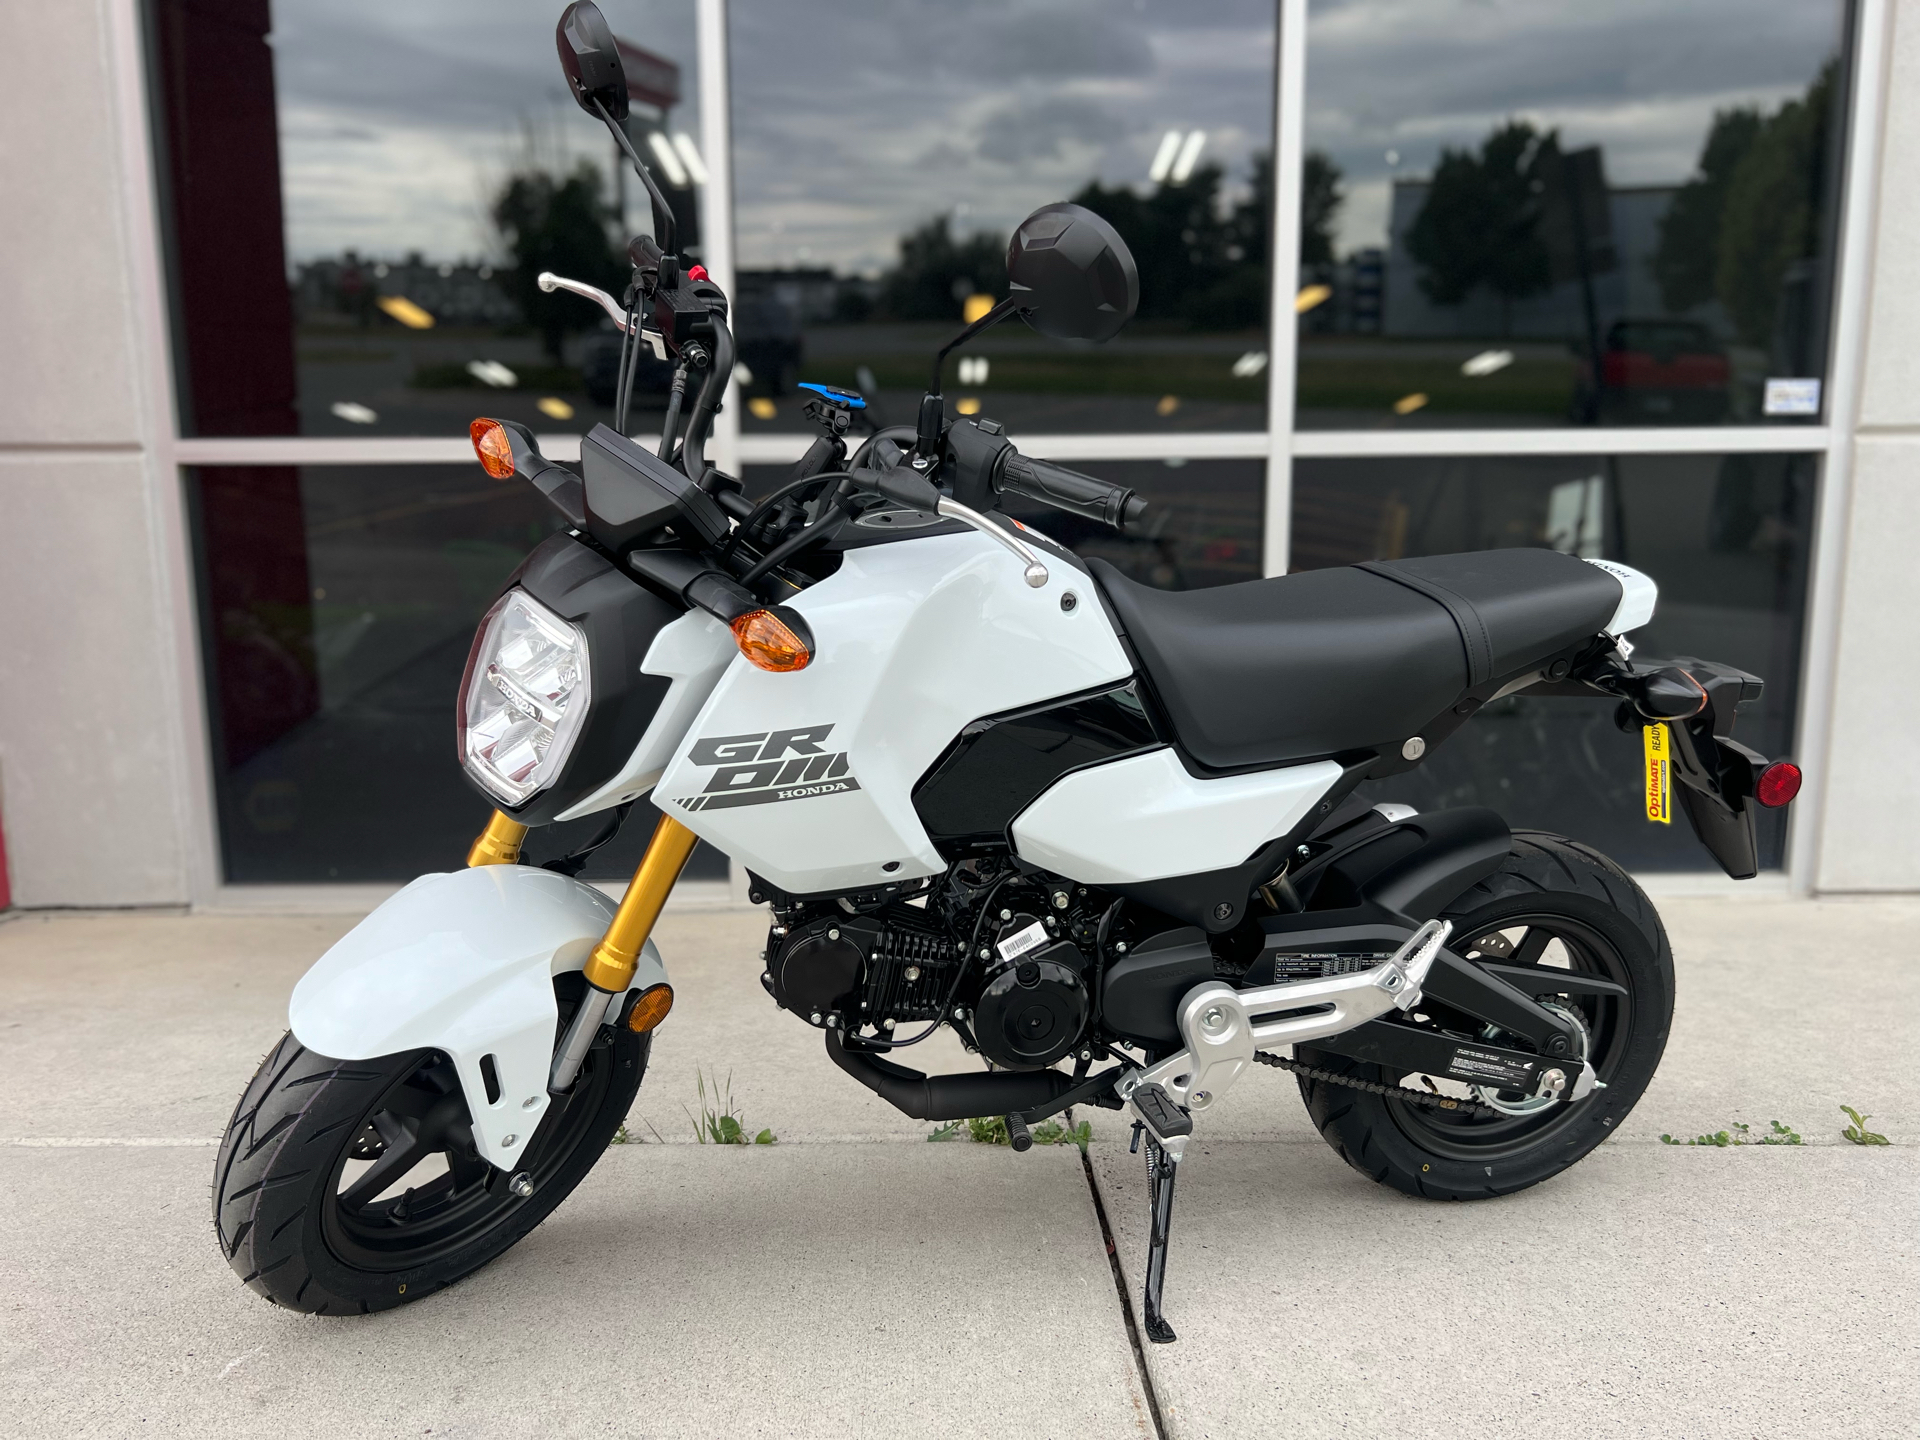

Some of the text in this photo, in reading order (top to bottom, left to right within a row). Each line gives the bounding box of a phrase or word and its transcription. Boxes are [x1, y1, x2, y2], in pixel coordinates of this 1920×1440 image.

[497, 679, 537, 718] HONDA
[1651, 724, 1661, 752] READY
[777, 781, 850, 800] HONDA
